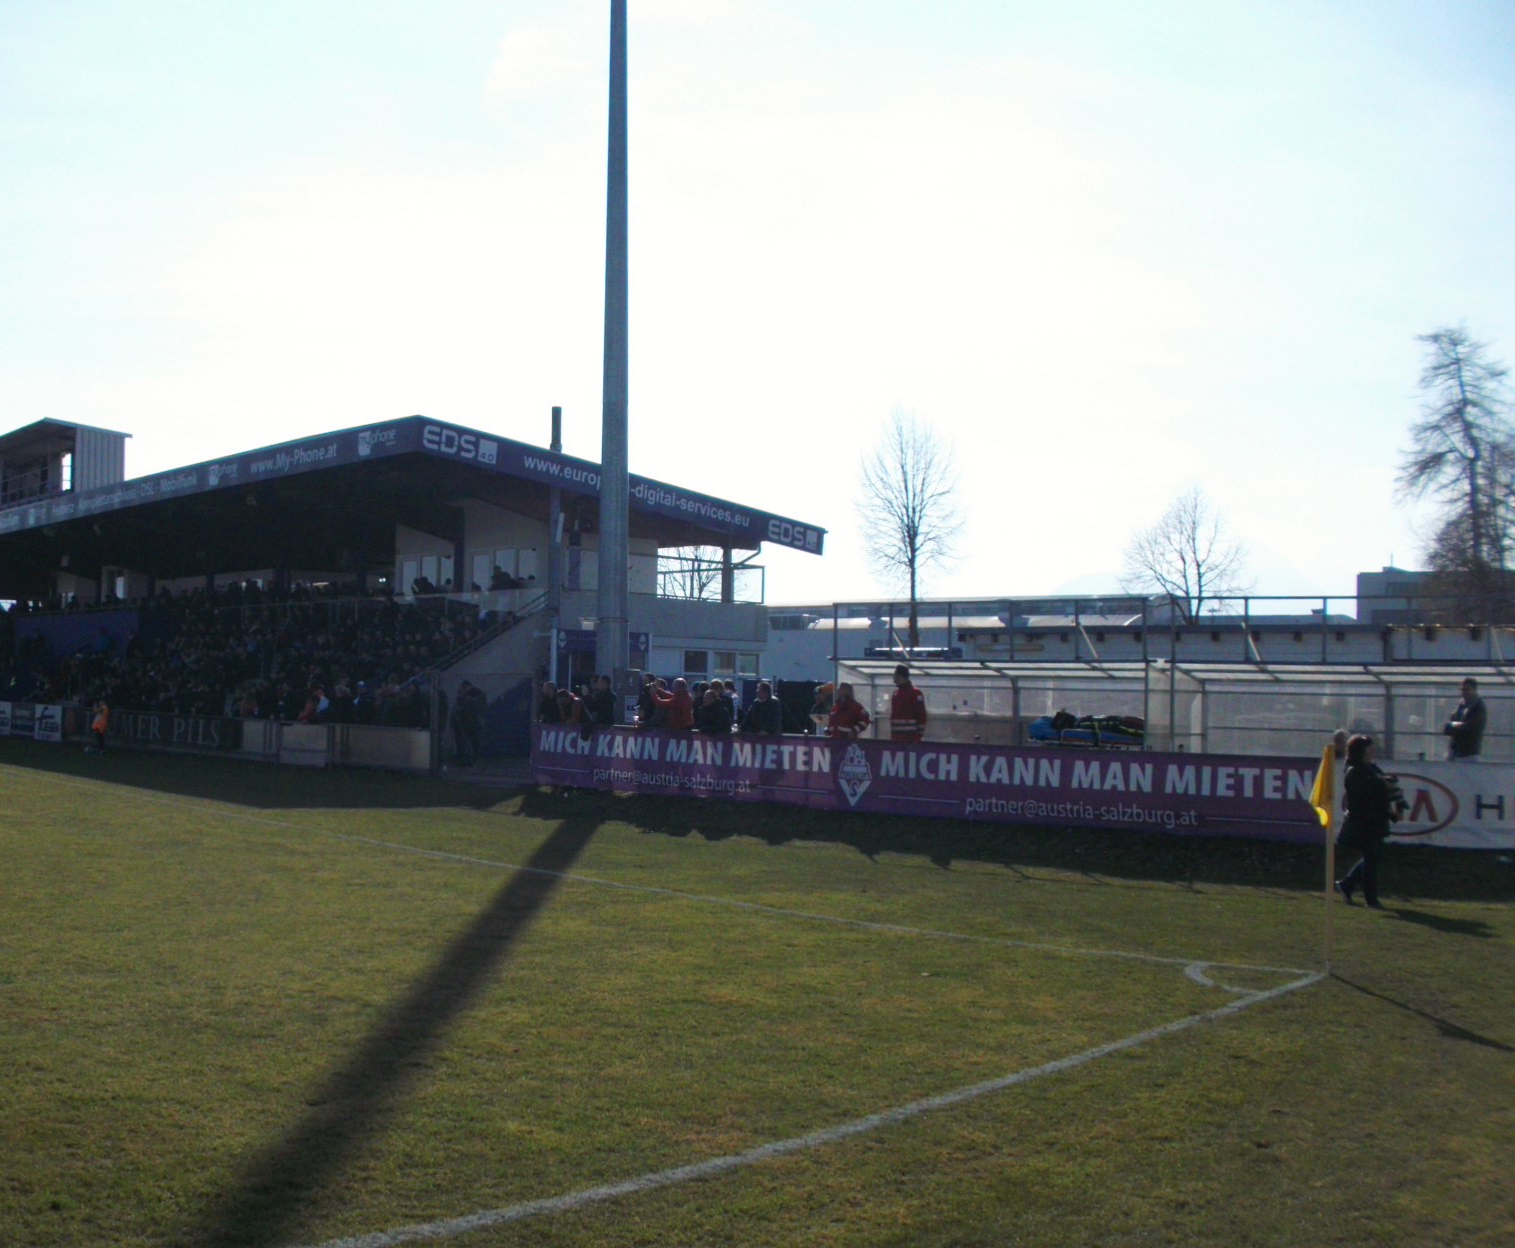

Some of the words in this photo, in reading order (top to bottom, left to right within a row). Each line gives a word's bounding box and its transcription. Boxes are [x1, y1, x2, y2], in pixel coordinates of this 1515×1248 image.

[423, 424, 476, 459] EDS
[250, 443, 337, 475] www.My-Phone.at
[523, 455, 750, 527] www.euro-digital-services.eu
[768, 519, 805, 546] EDS
[84, 711, 161, 740] TUMER
[172, 718, 220, 747] PILS
[539, 729, 590, 755] MICH
[596, 733, 659, 761] KANN
[665, 738, 722, 766] MAN
[730, 742, 831, 773] MIETEN
[593, 766, 751, 795] partner@austria-salzburg.at
[879, 750, 959, 782] MICH
[968, 755, 1061, 788] KANN
[1071, 760, 1153, 793] MAN
[1165, 764, 1313, 800] MIETEN
[965, 796, 1198, 829] partner@austria-salzburg.at
[1475, 794, 1515, 820] H
